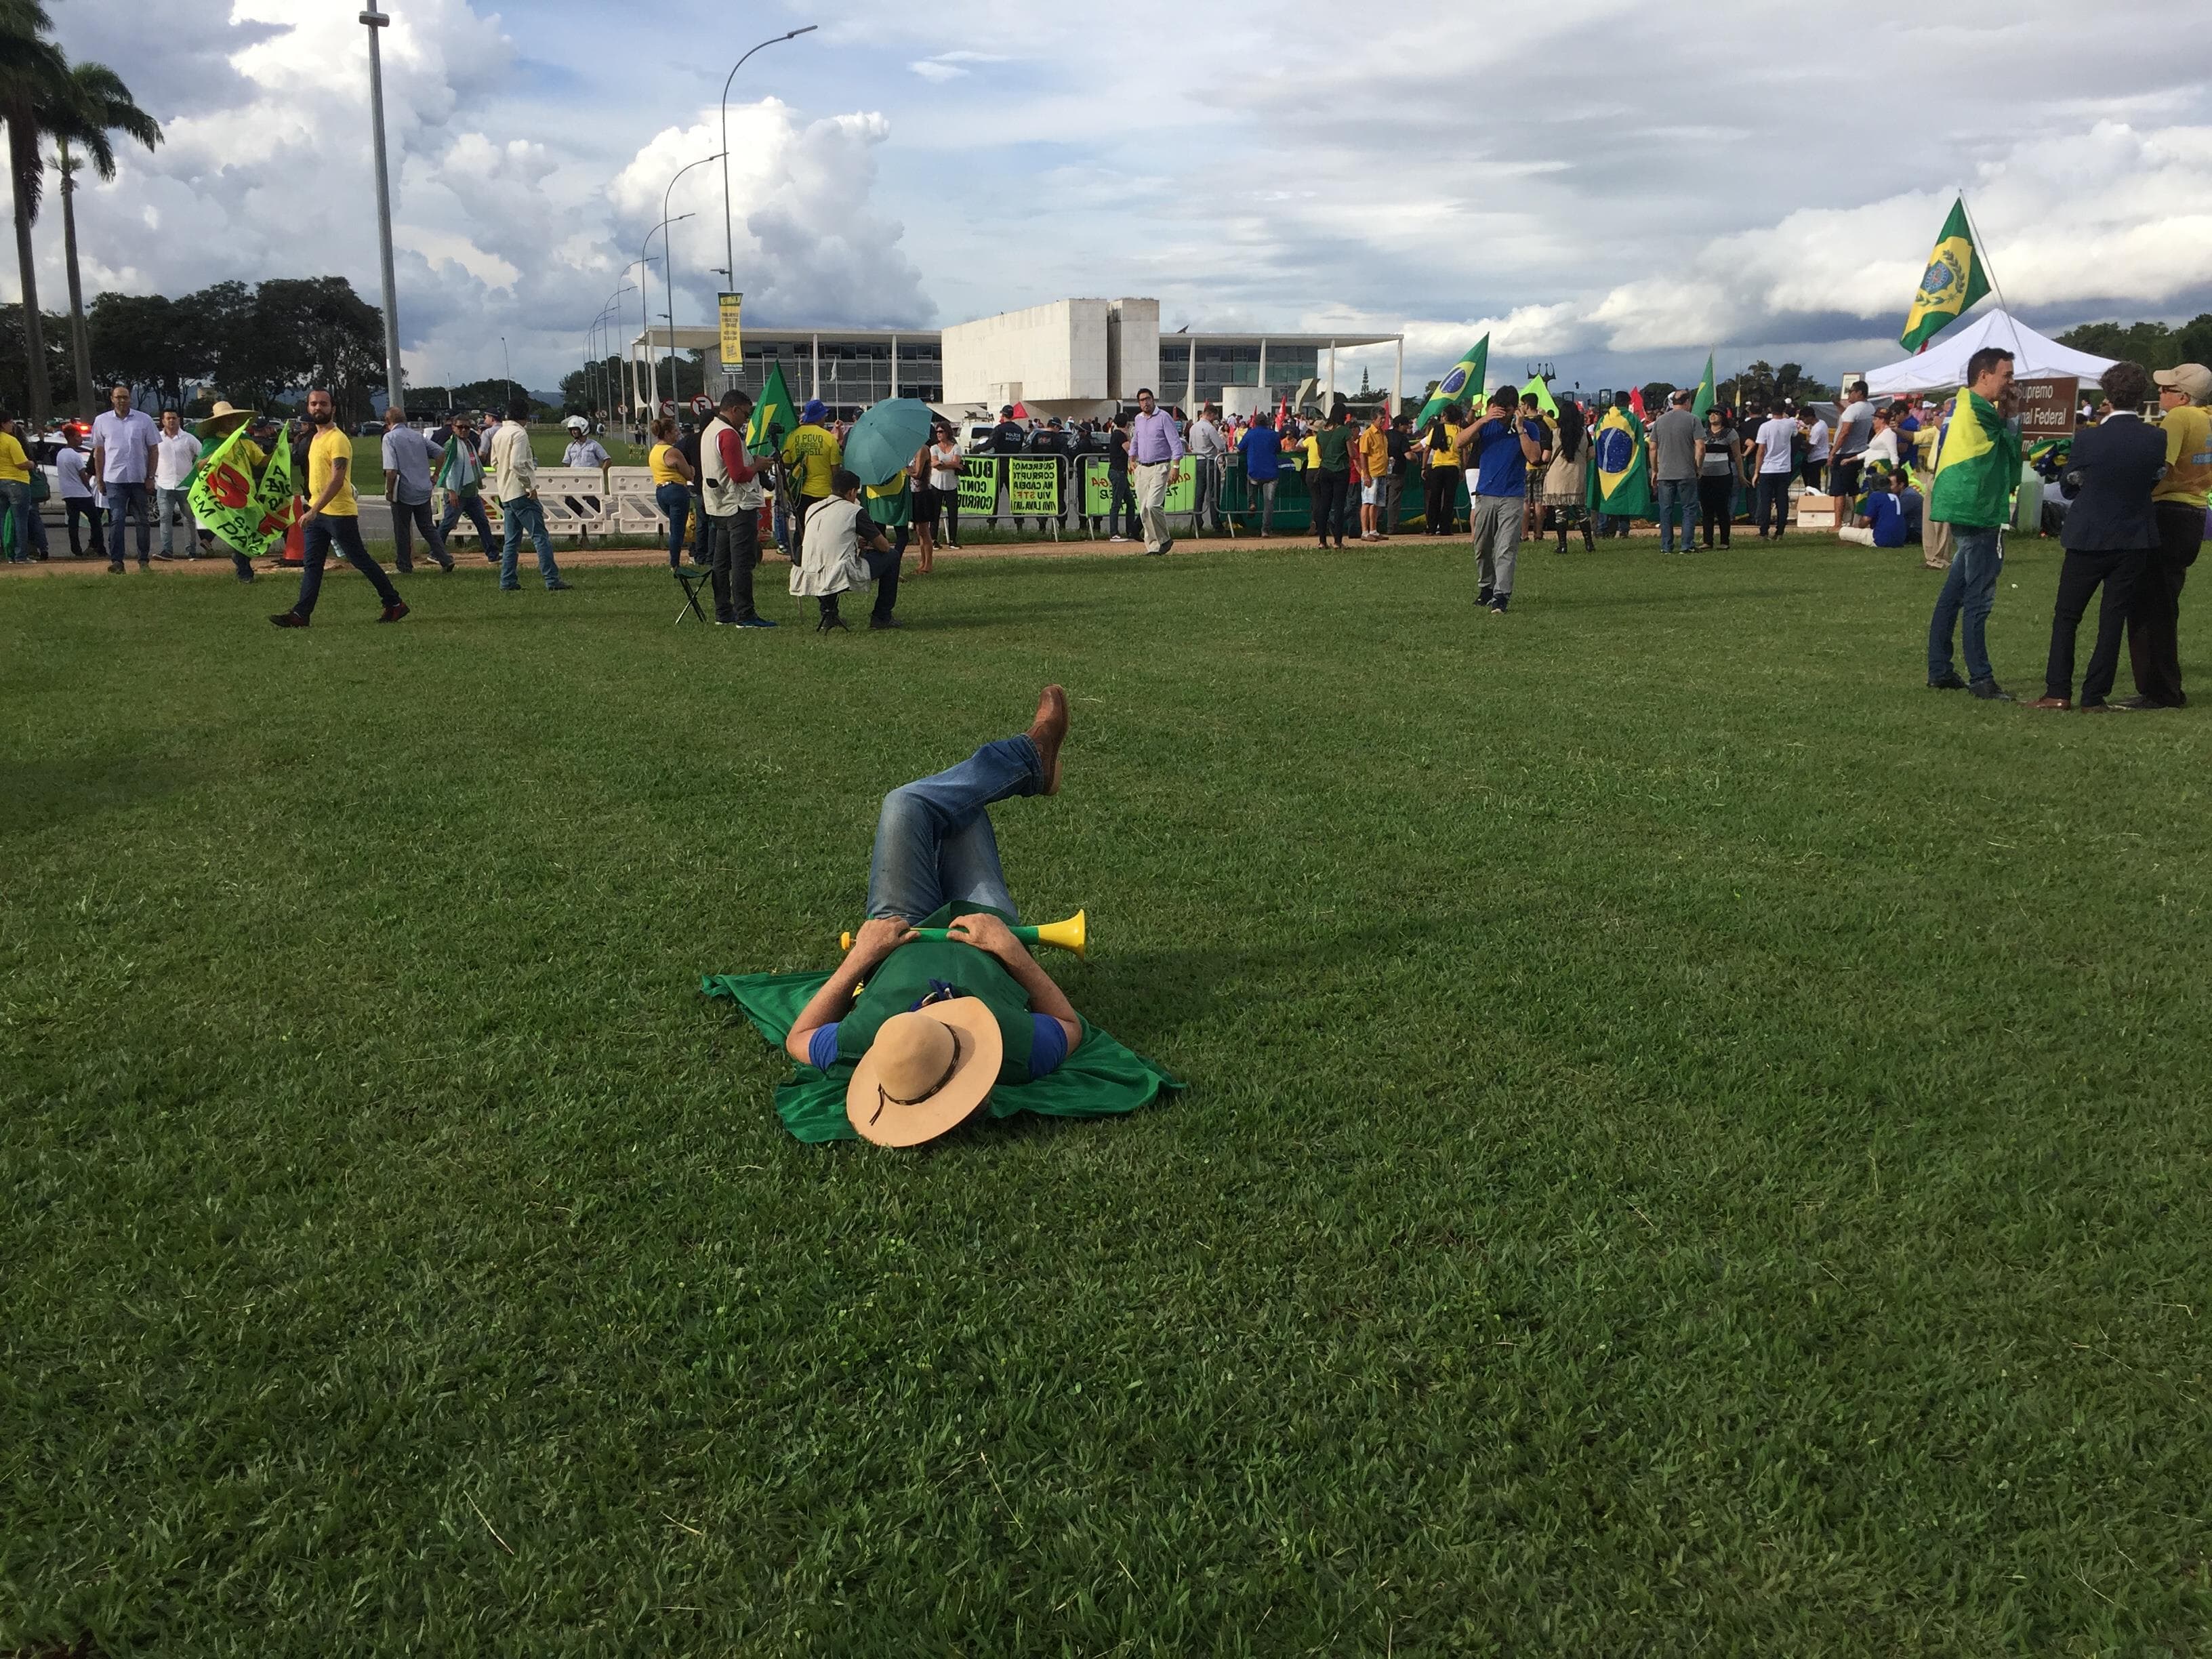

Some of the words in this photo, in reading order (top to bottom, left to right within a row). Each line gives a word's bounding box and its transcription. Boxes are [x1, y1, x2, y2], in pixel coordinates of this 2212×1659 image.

[2018, 382, 2053, 403] Supremo
[2034, 408, 2066, 426] Federal
[802, 434, 823, 443] POVO
